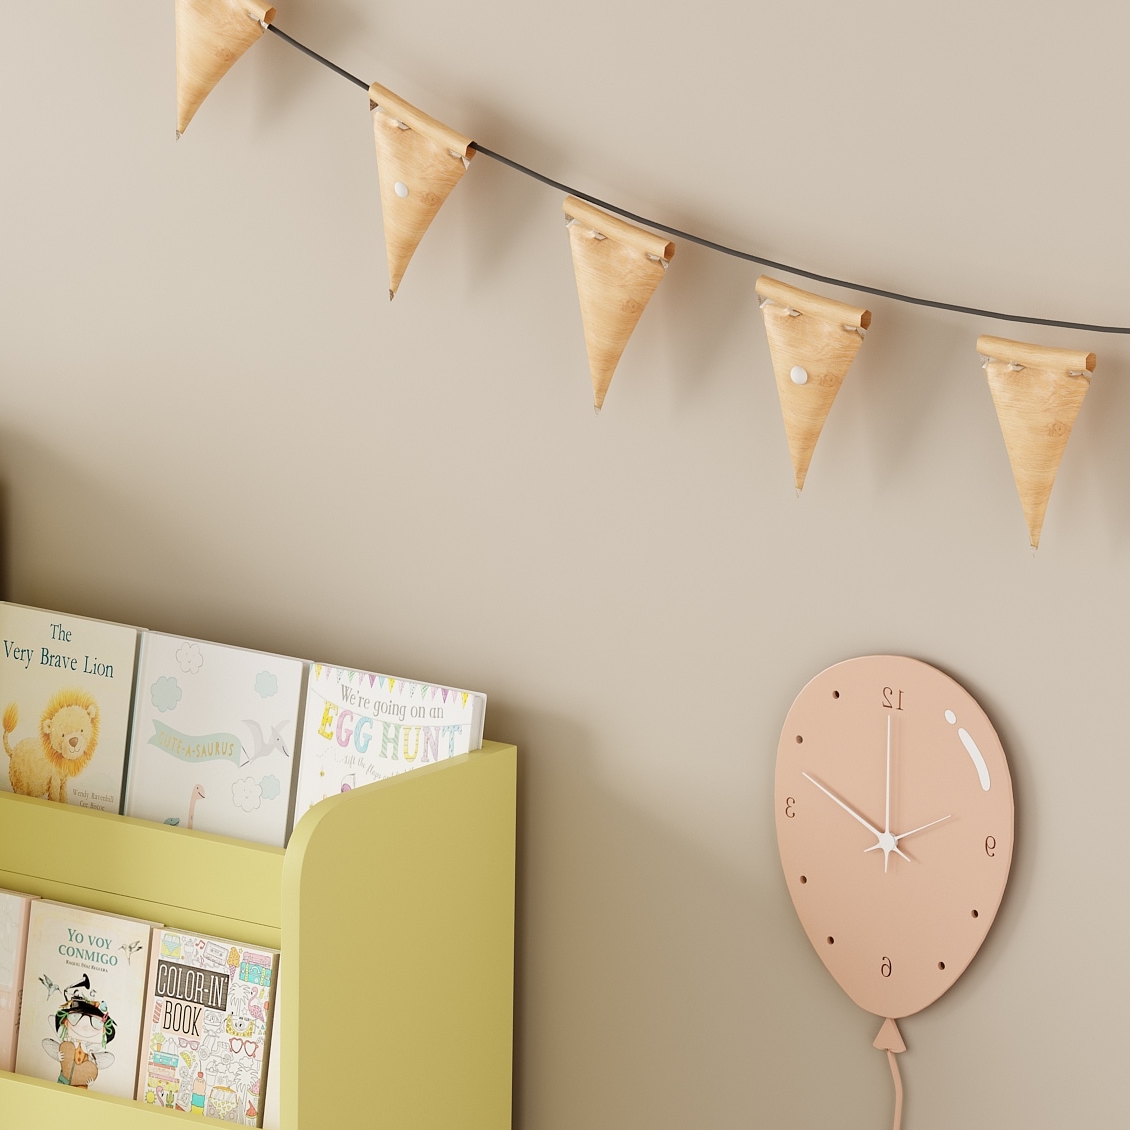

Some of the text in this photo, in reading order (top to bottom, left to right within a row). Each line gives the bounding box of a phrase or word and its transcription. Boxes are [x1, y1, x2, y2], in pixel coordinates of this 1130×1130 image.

[50, 623, 72, 642] The
[3, 639, 114, 678] Very Brave Lion
[341, 684, 444, 722] We're going on an
[158, 731, 235, 759] CUTE-A-SAURUS
[318, 700, 463, 763] EGG HUNT
[58, 944, 118, 966] CONMIGO
[68, 928, 112, 950] YO VOY
[162, 1000, 203, 1037] BOOK
